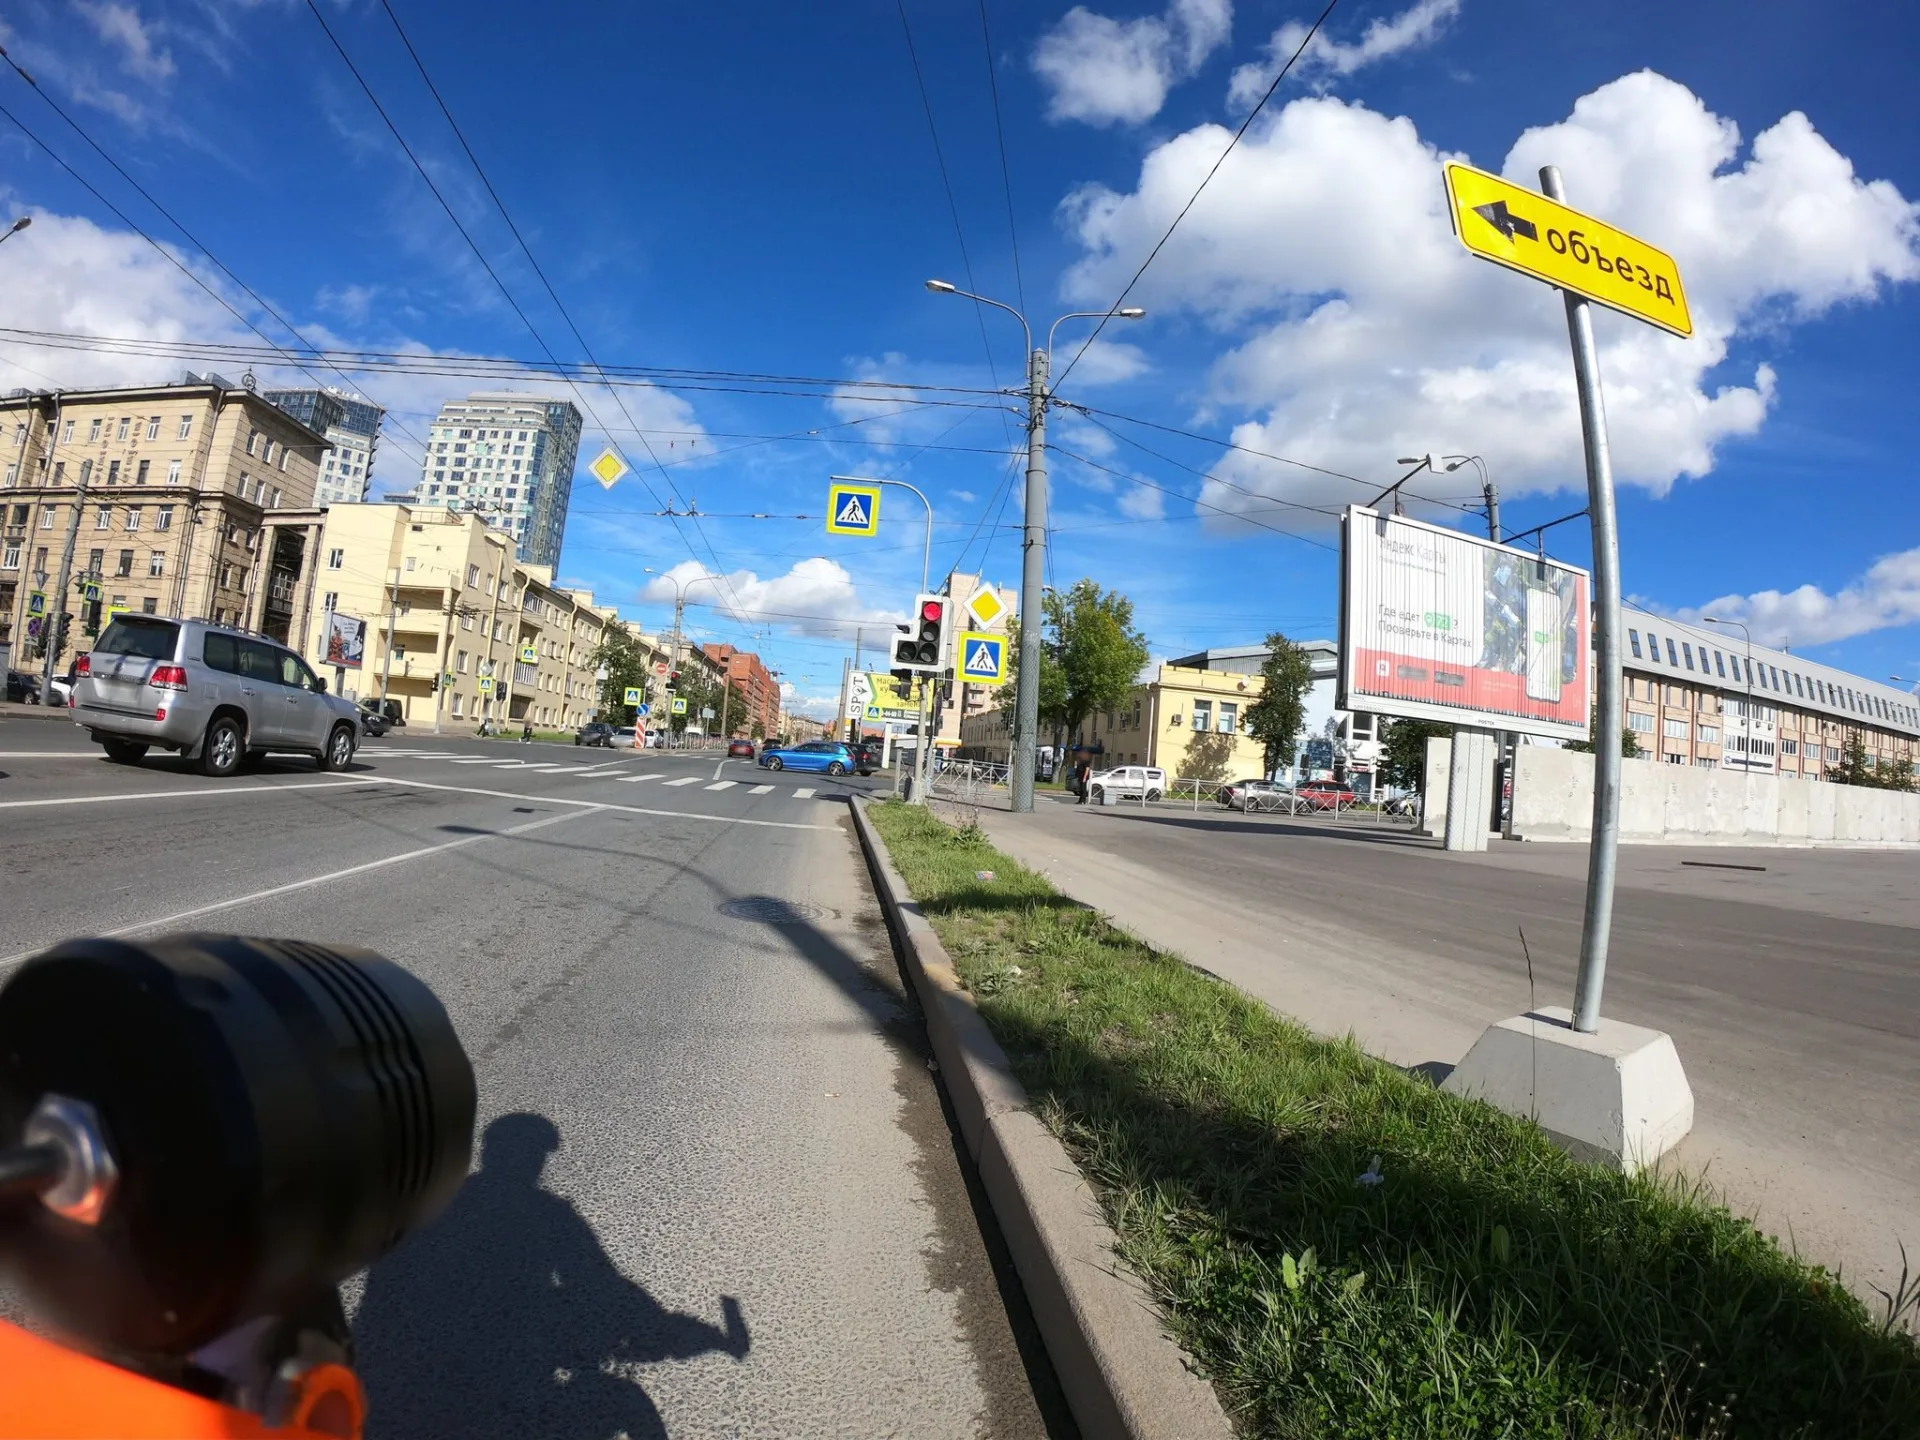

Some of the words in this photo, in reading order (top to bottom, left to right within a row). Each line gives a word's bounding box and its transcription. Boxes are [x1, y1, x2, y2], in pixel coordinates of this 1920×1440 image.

[1546, 228, 1675, 306] объезд
[1378, 604, 1396, 618] Где
[1398, 611, 1421, 622] едет
[1378, 620, 1432, 640] Проверьте
[1433, 633, 1439, 641] в
[1440, 632, 1472, 649] Картах
